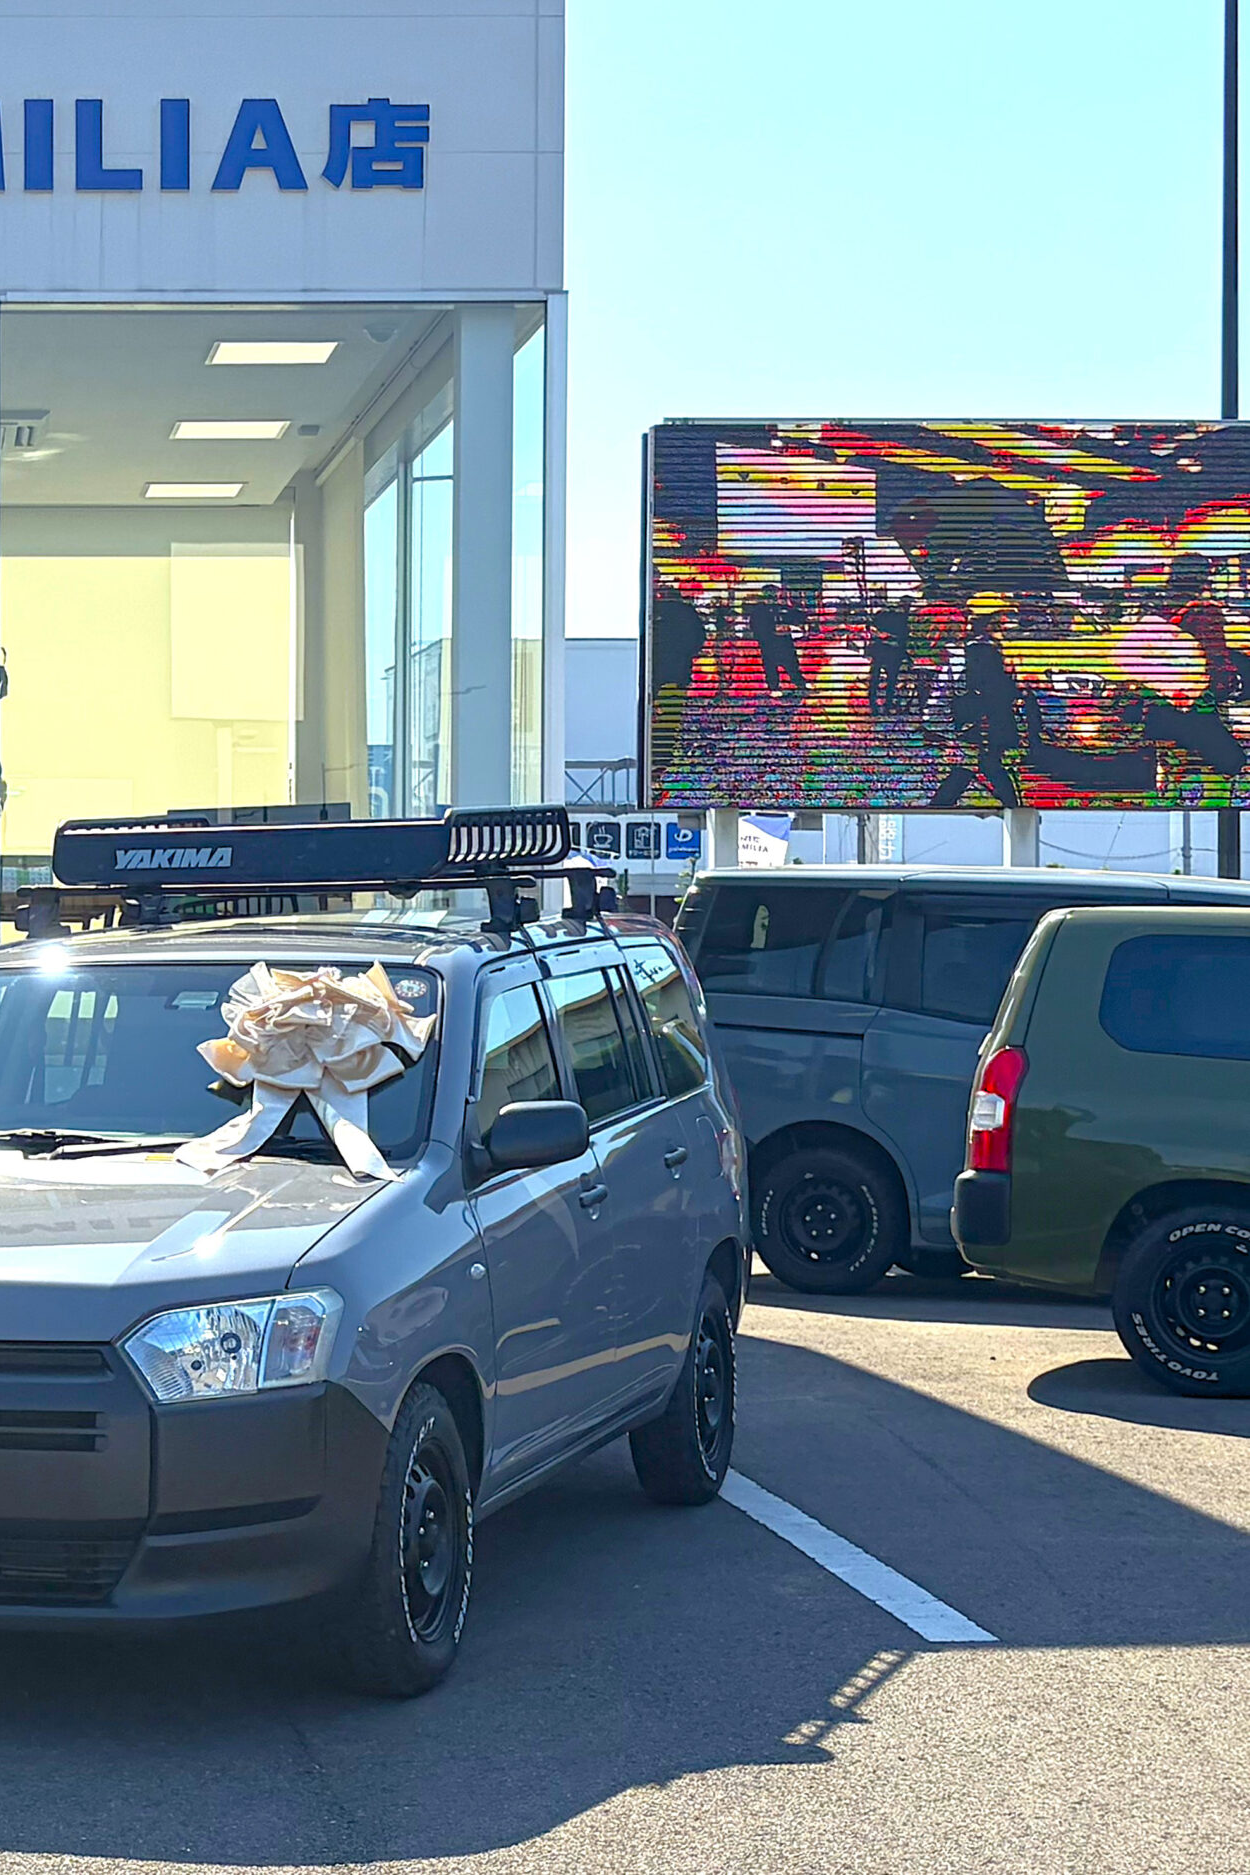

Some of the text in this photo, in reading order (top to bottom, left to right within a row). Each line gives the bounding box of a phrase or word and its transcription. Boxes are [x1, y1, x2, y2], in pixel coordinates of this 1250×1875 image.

[114, 847, 233, 870] YAKIMA
[1169, 1223, 1222, 1242] OPEN
[1131, 1312, 1219, 1381] TOYO TIRES
